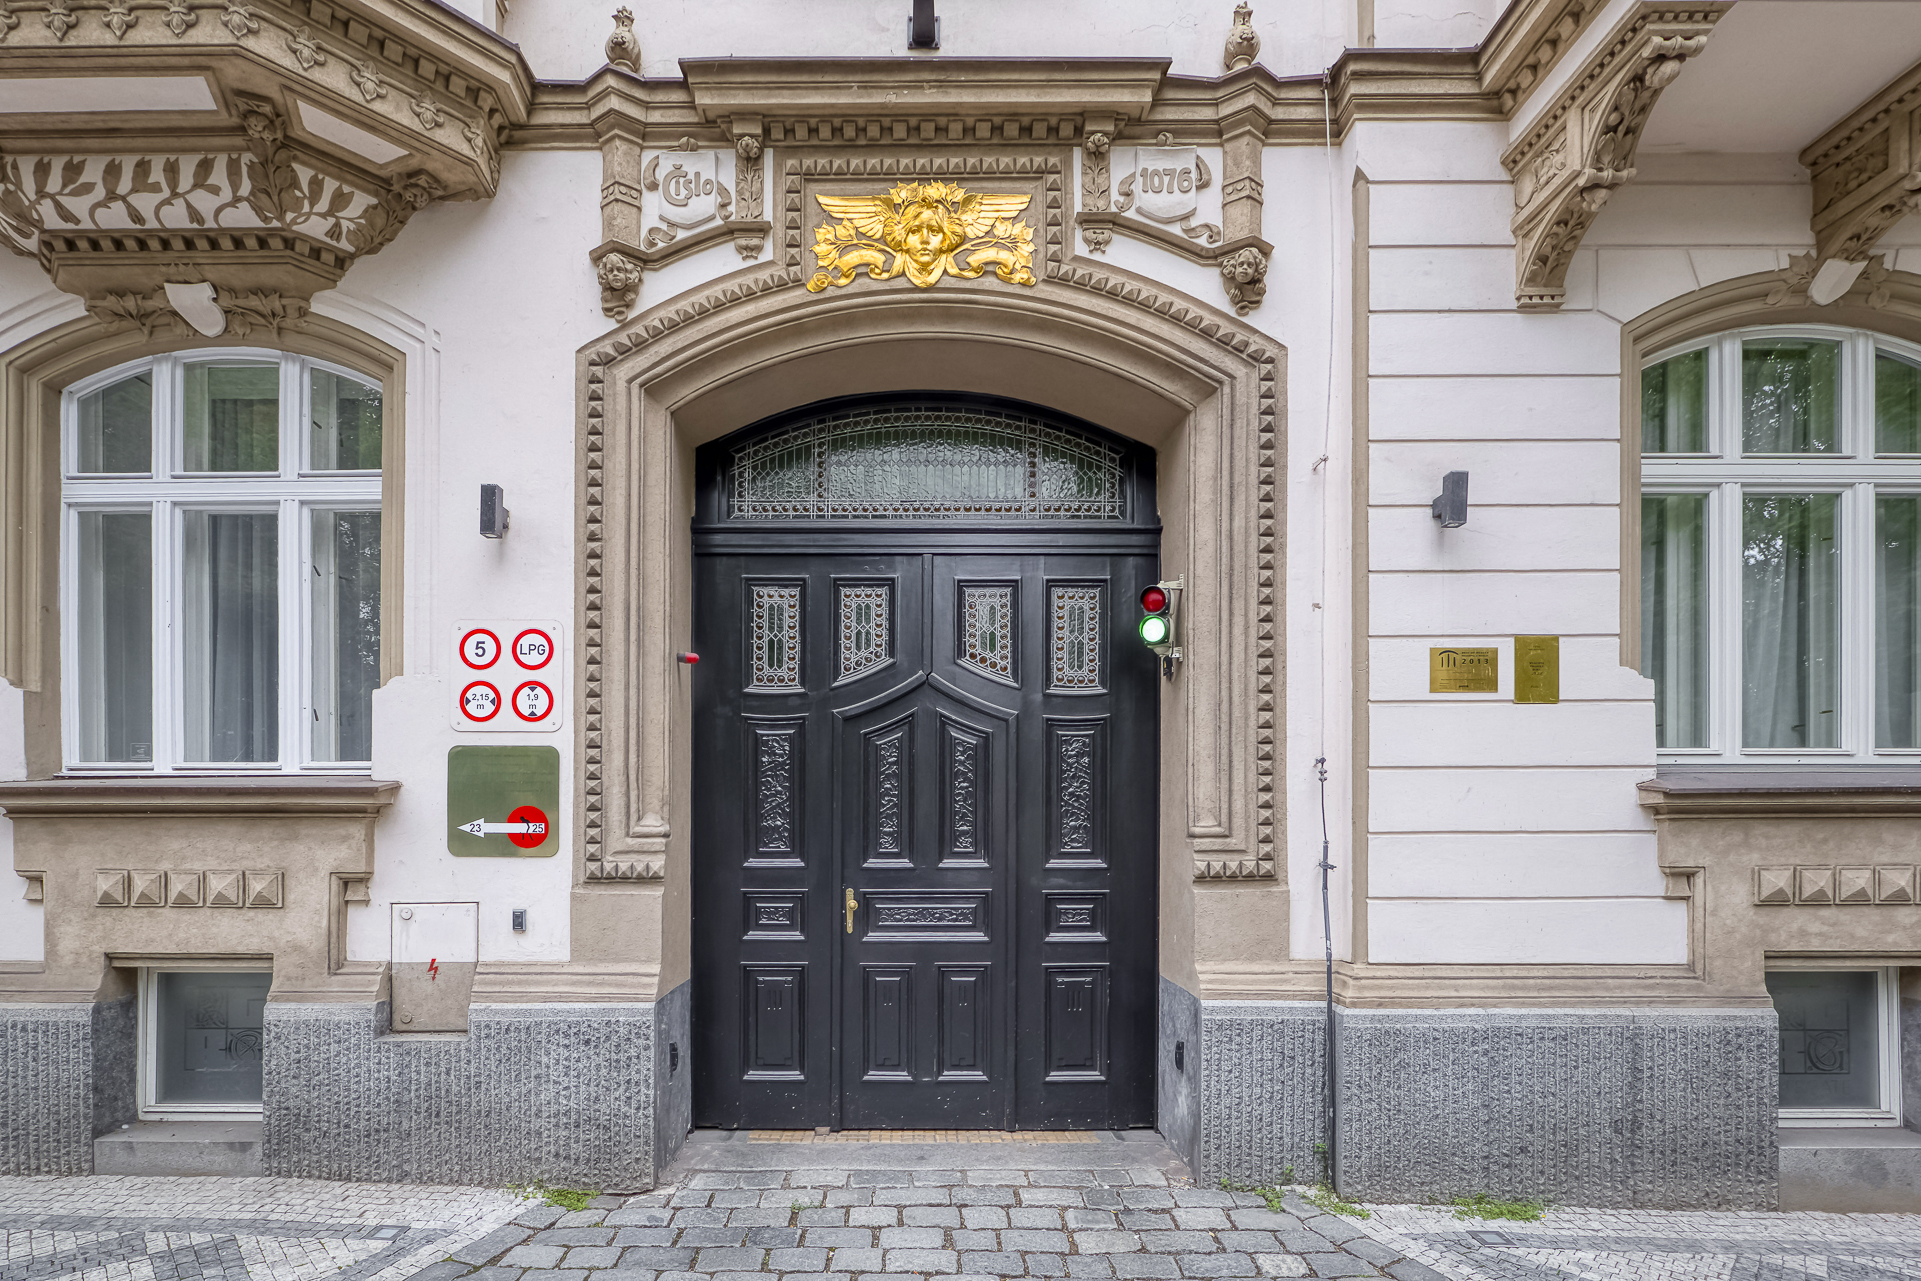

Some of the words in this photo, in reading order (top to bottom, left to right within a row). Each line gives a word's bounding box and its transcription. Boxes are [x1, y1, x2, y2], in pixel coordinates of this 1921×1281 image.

[662, 164, 714, 207] Číslo
[1140, 167, 1193, 194] 1076
[474, 641, 486, 657] 5
[519, 643, 546, 656] LPG
[471, 693, 490, 702] 2,15
[526, 693, 539, 702] 1,9
[469, 823, 482, 833] 23
[532, 823, 544, 833] 25
